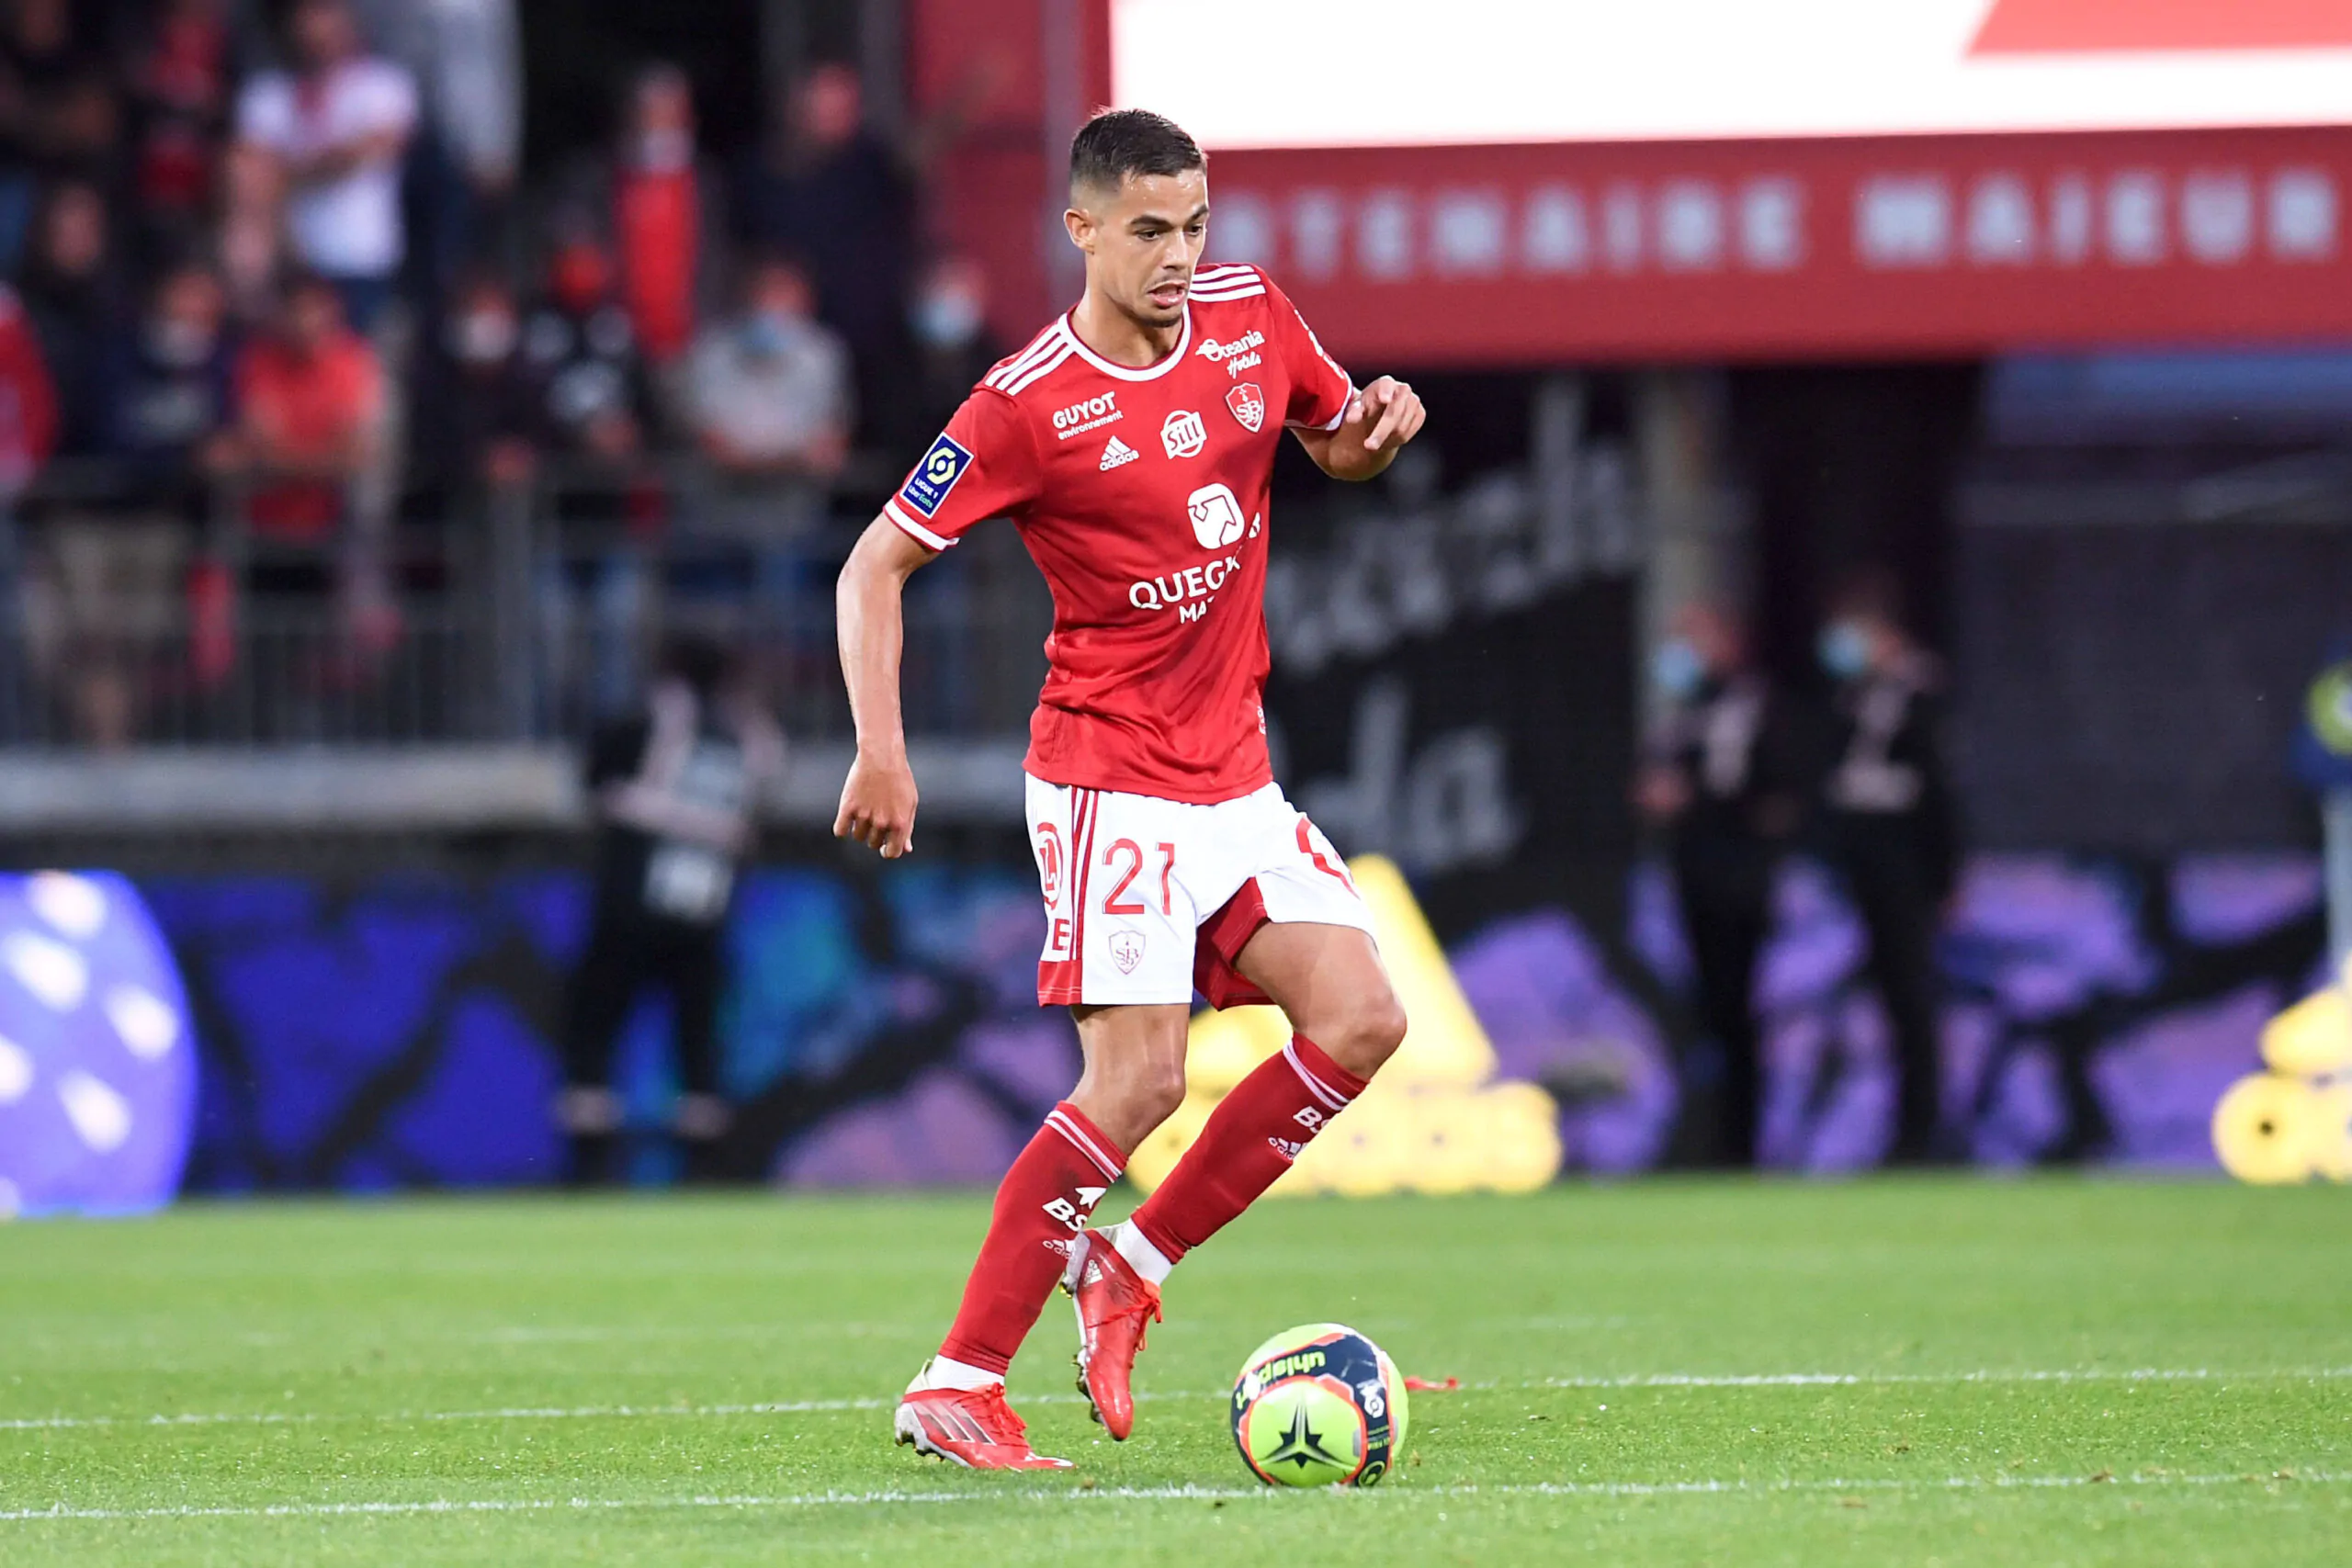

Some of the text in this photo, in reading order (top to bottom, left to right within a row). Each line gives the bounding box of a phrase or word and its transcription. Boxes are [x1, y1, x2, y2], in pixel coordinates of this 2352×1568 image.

[1207, 178, 1808, 283] RTENAIRE
[1195, 330, 1265, 362] Oceania
[1052, 390, 1115, 429] GUYOT
[1057, 410, 1124, 440] environnement
[1099, 449, 1140, 471] adidas
[914, 477, 934, 496] LIGUE
[1179, 596, 1215, 624] MA
[1102, 838, 1176, 916] 21
